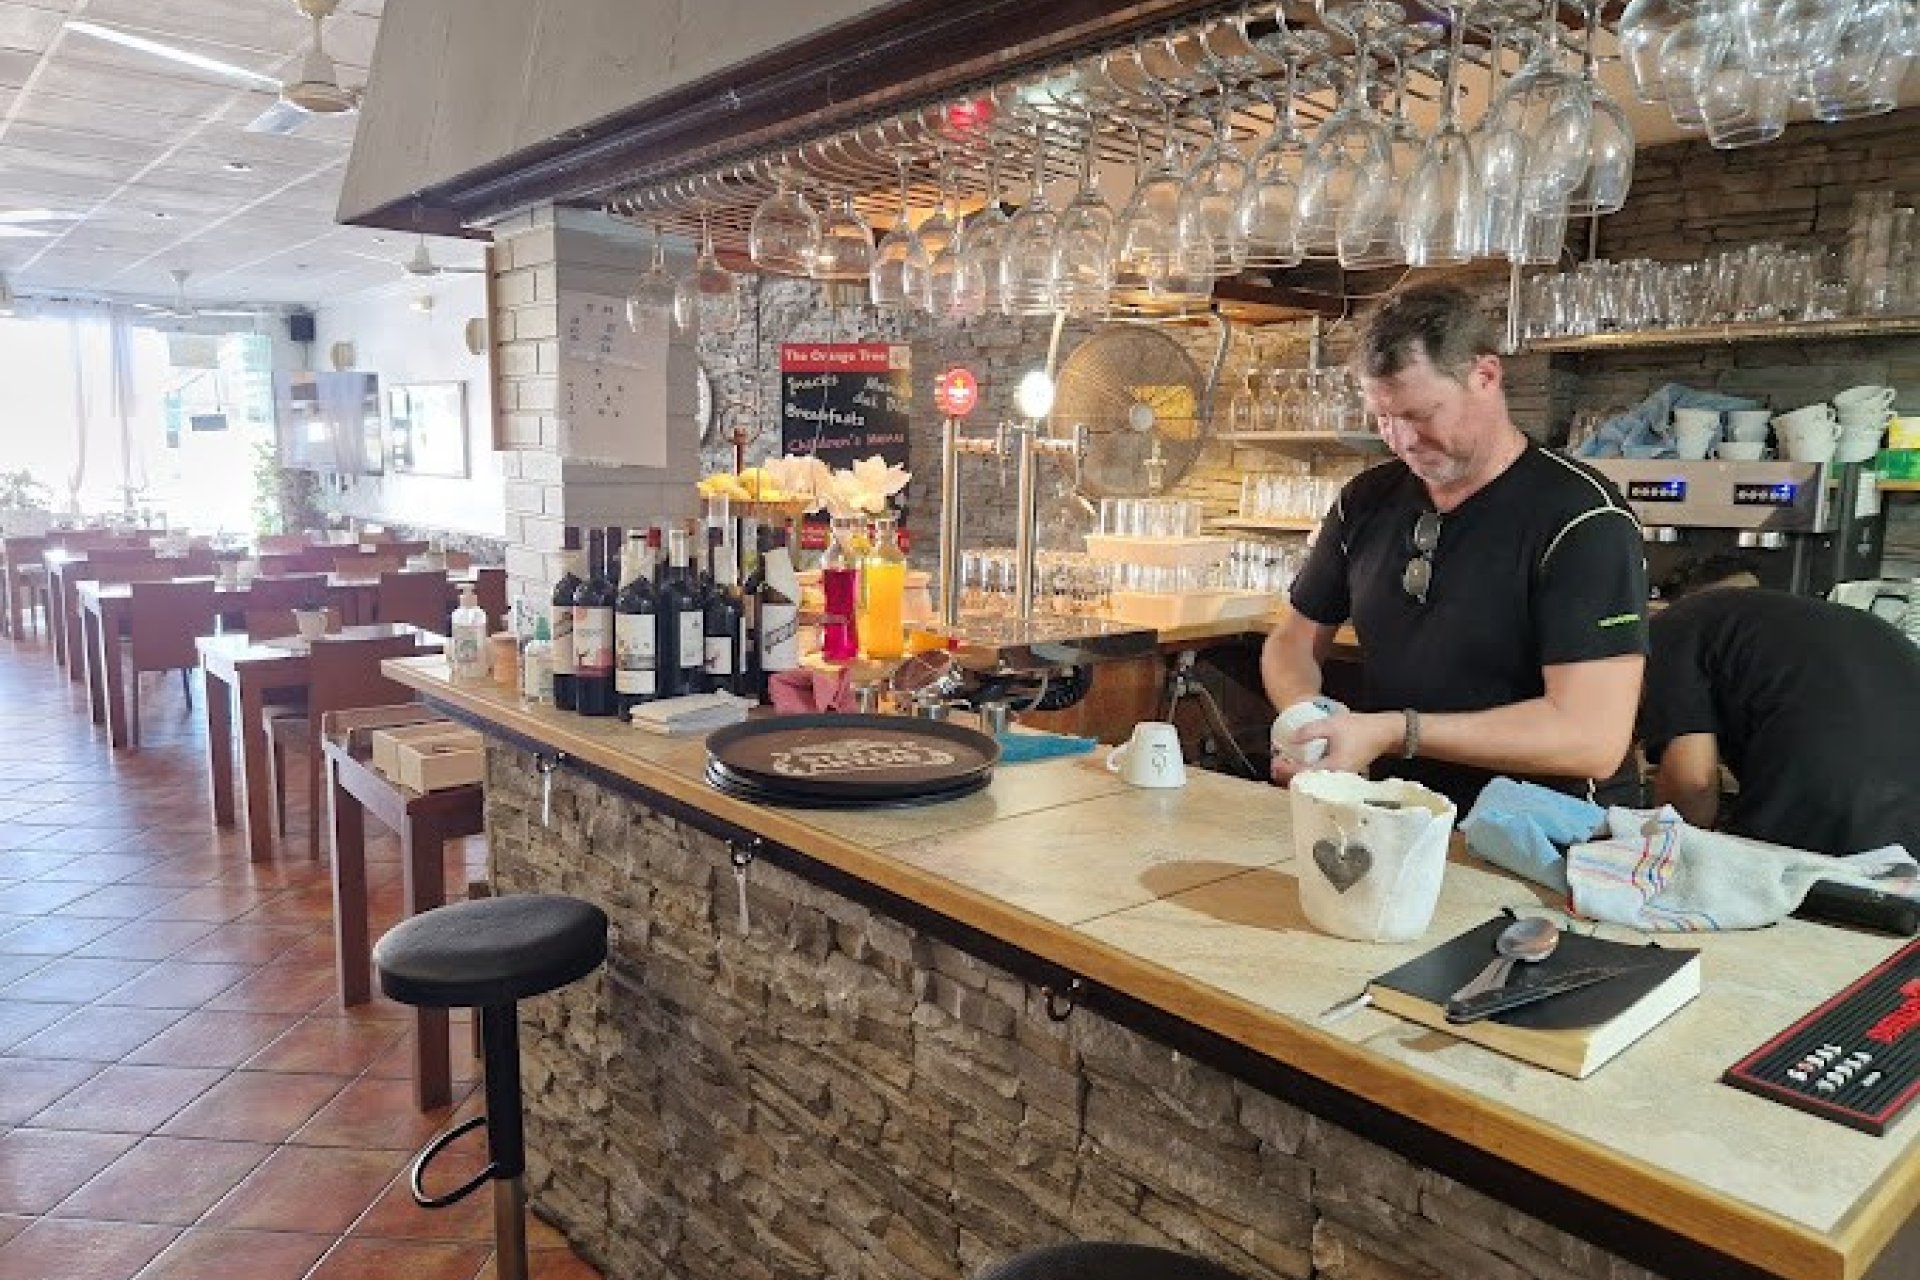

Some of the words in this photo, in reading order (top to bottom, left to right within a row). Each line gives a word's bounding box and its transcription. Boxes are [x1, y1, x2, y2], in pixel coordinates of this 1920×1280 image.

[785, 349, 808, 361] The
[810, 349, 856, 364] Orange
[858, 349, 887, 361] Tree
[785, 403, 865, 426] Breakfasts
